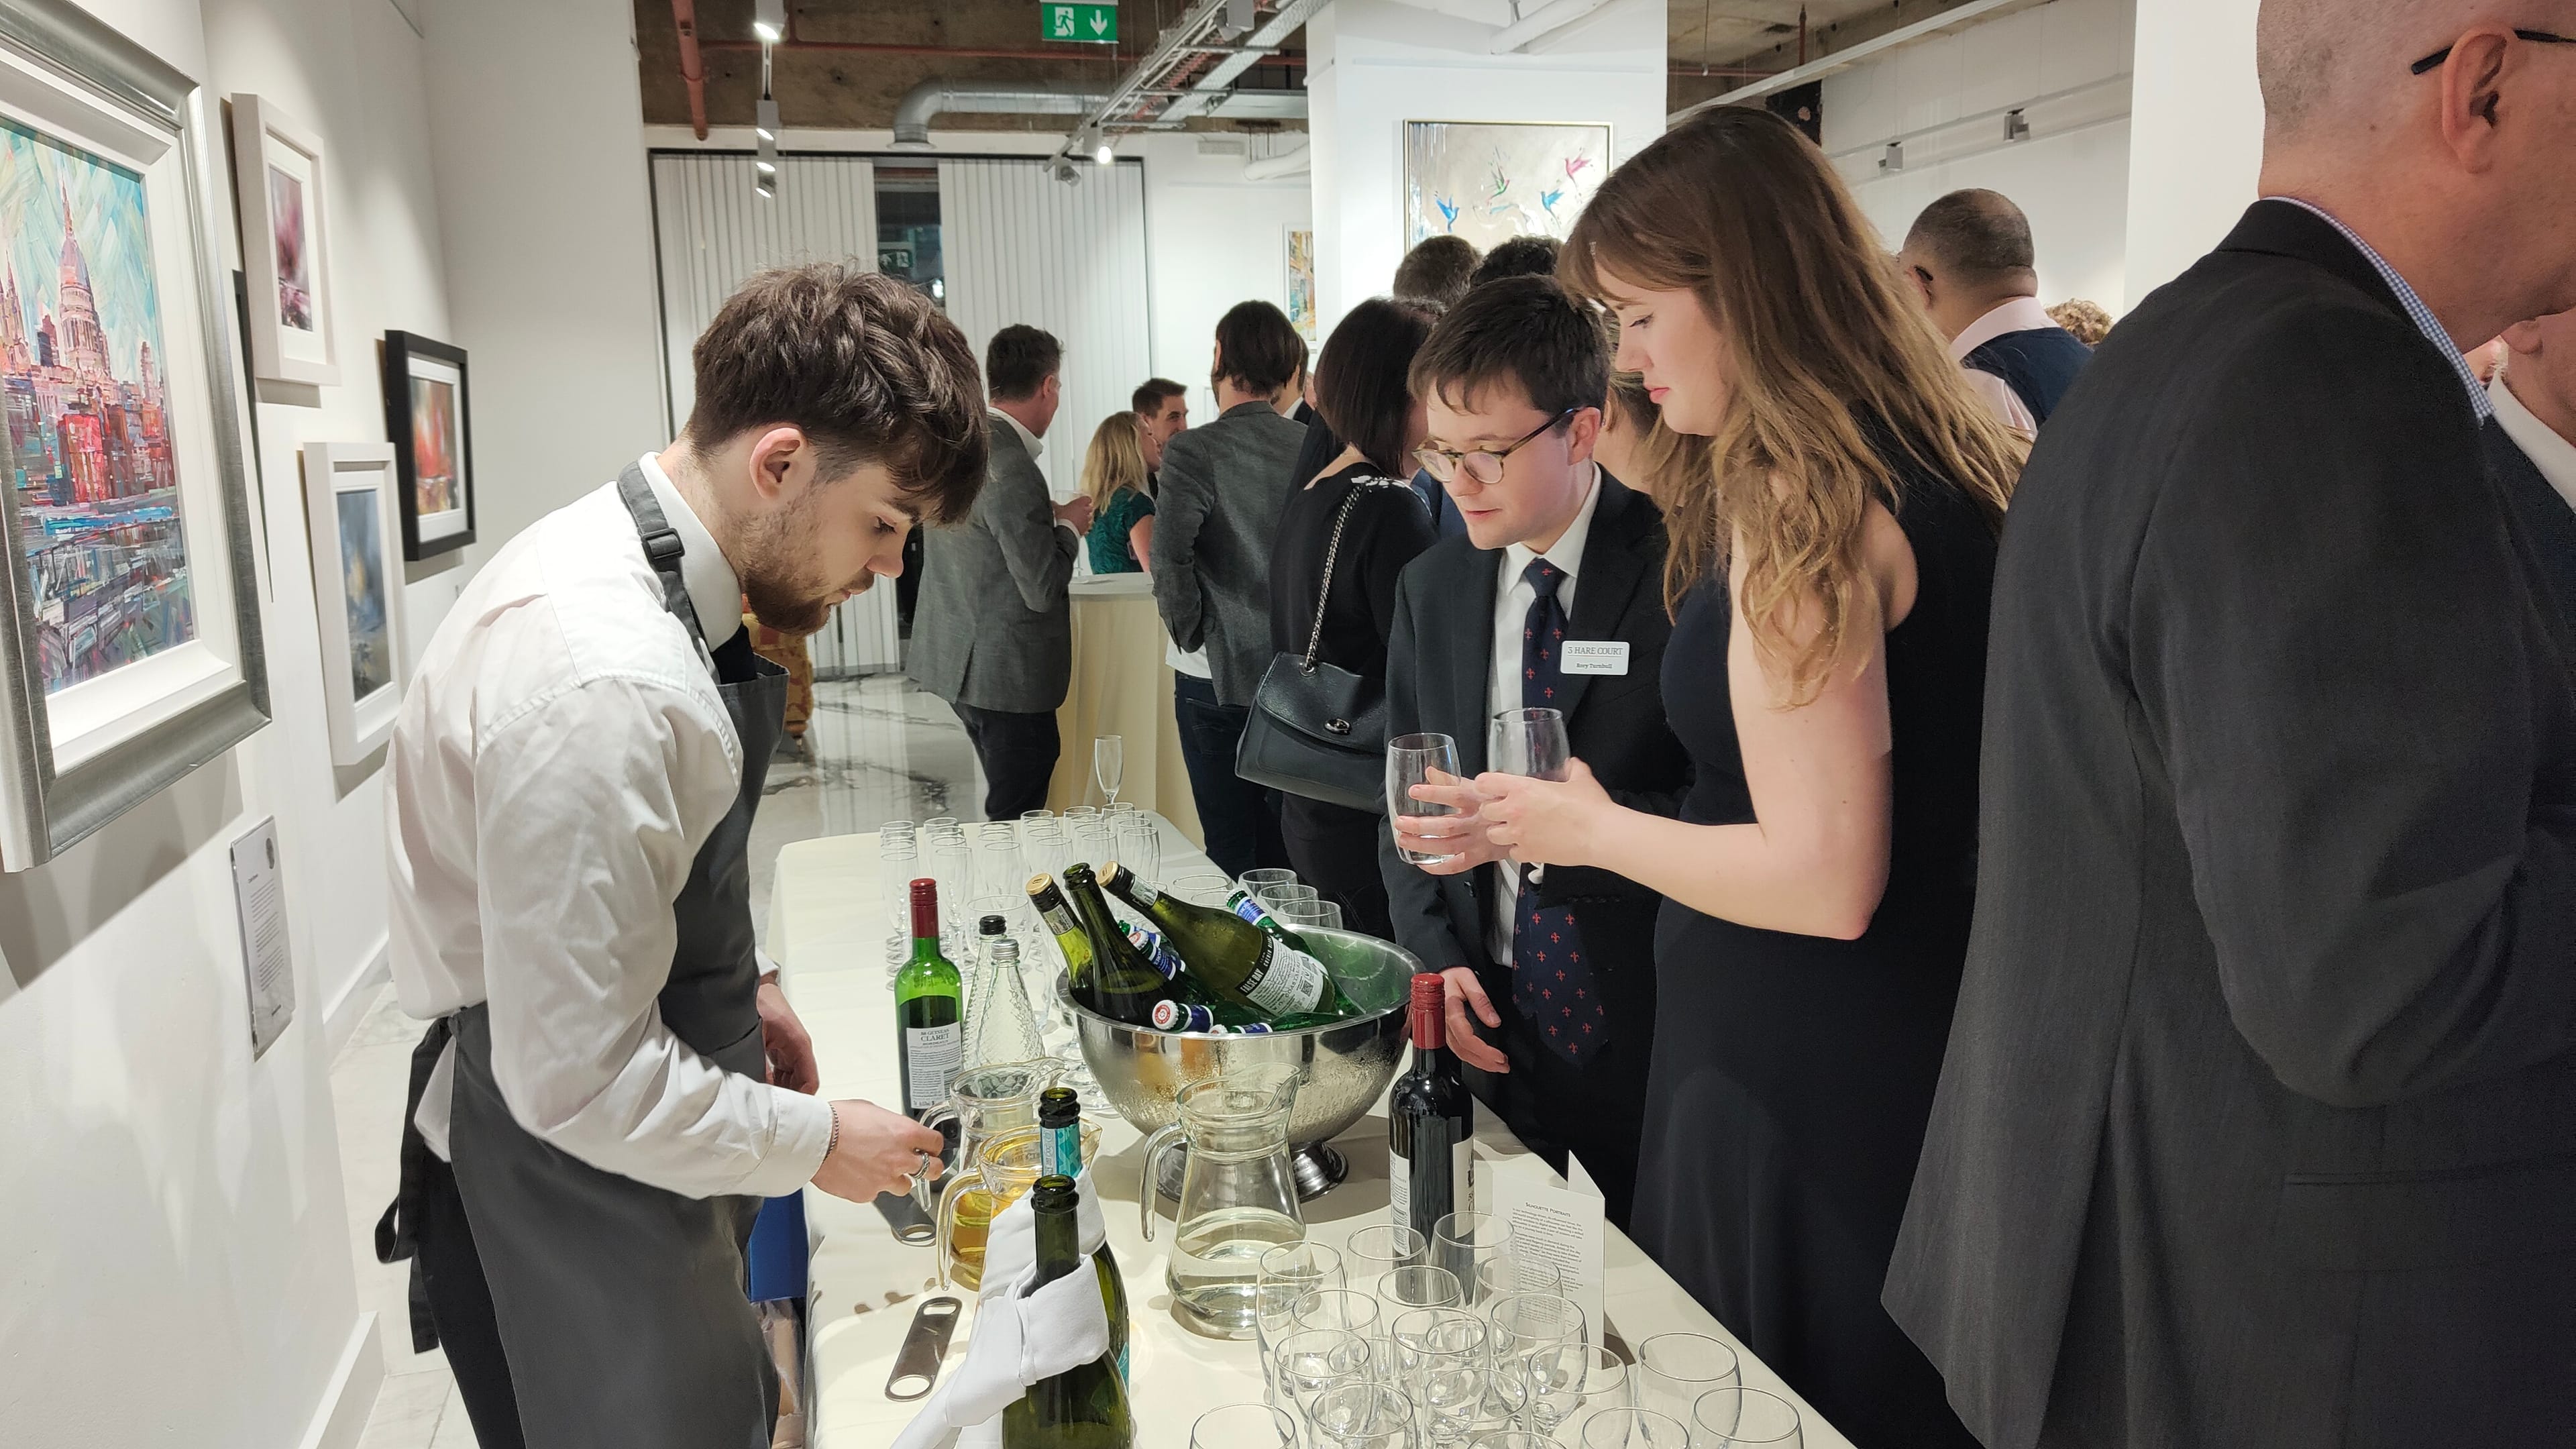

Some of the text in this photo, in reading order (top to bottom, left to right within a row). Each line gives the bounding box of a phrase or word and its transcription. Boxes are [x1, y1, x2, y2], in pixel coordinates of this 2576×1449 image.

[1597, 647, 1623, 655] COURT
[1240, 968, 1265, 994] FALSE BAY
[920, 1033, 950, 1042] CLARET
[1550, 1208, 1570, 1217] PORTRAITS
